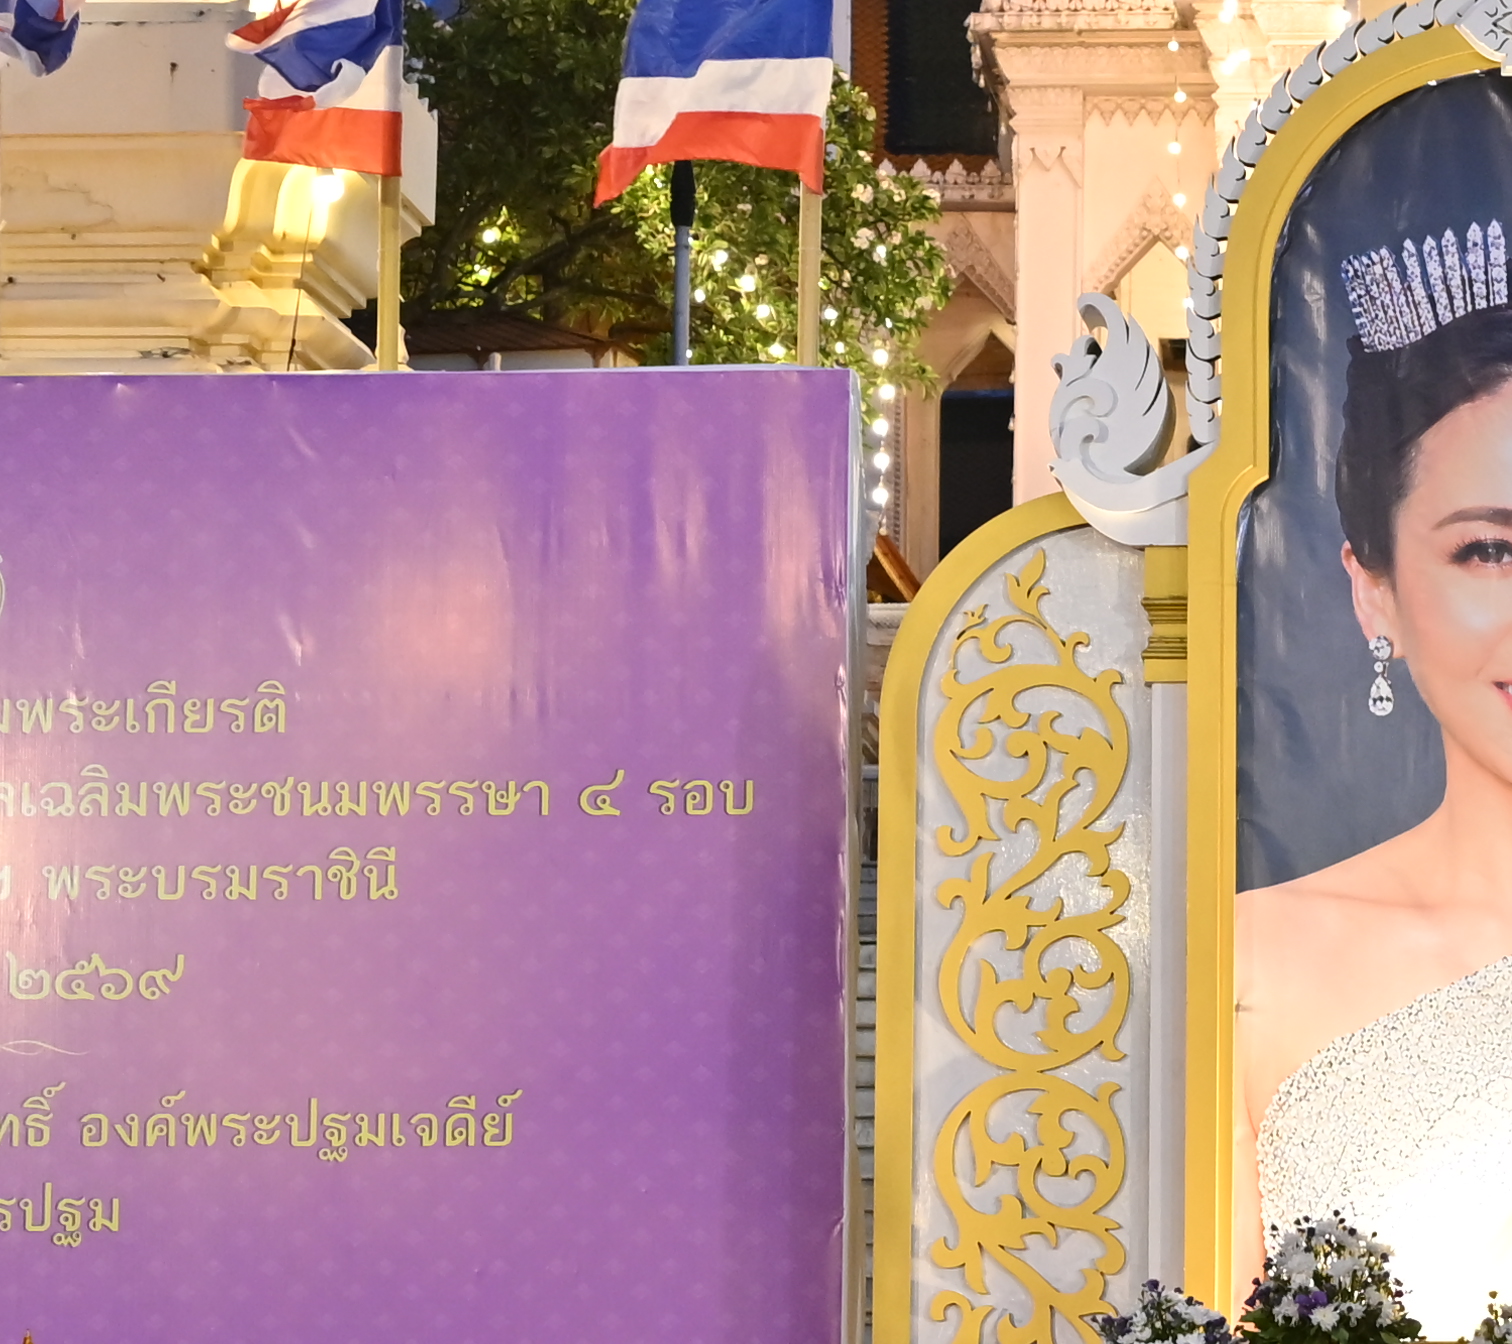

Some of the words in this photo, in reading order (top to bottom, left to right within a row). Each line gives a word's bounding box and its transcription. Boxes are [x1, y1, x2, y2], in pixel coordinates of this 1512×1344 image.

[578, 769, 626, 817] ๔
[649, 776, 755, 817] รอบ
[43, 846, 399, 902] พระบรมราชินี
[6, 951, 185, 1001] ๒๕๖๙
[80, 1089, 523, 1162] องค์พระปฐมเจดีย์
